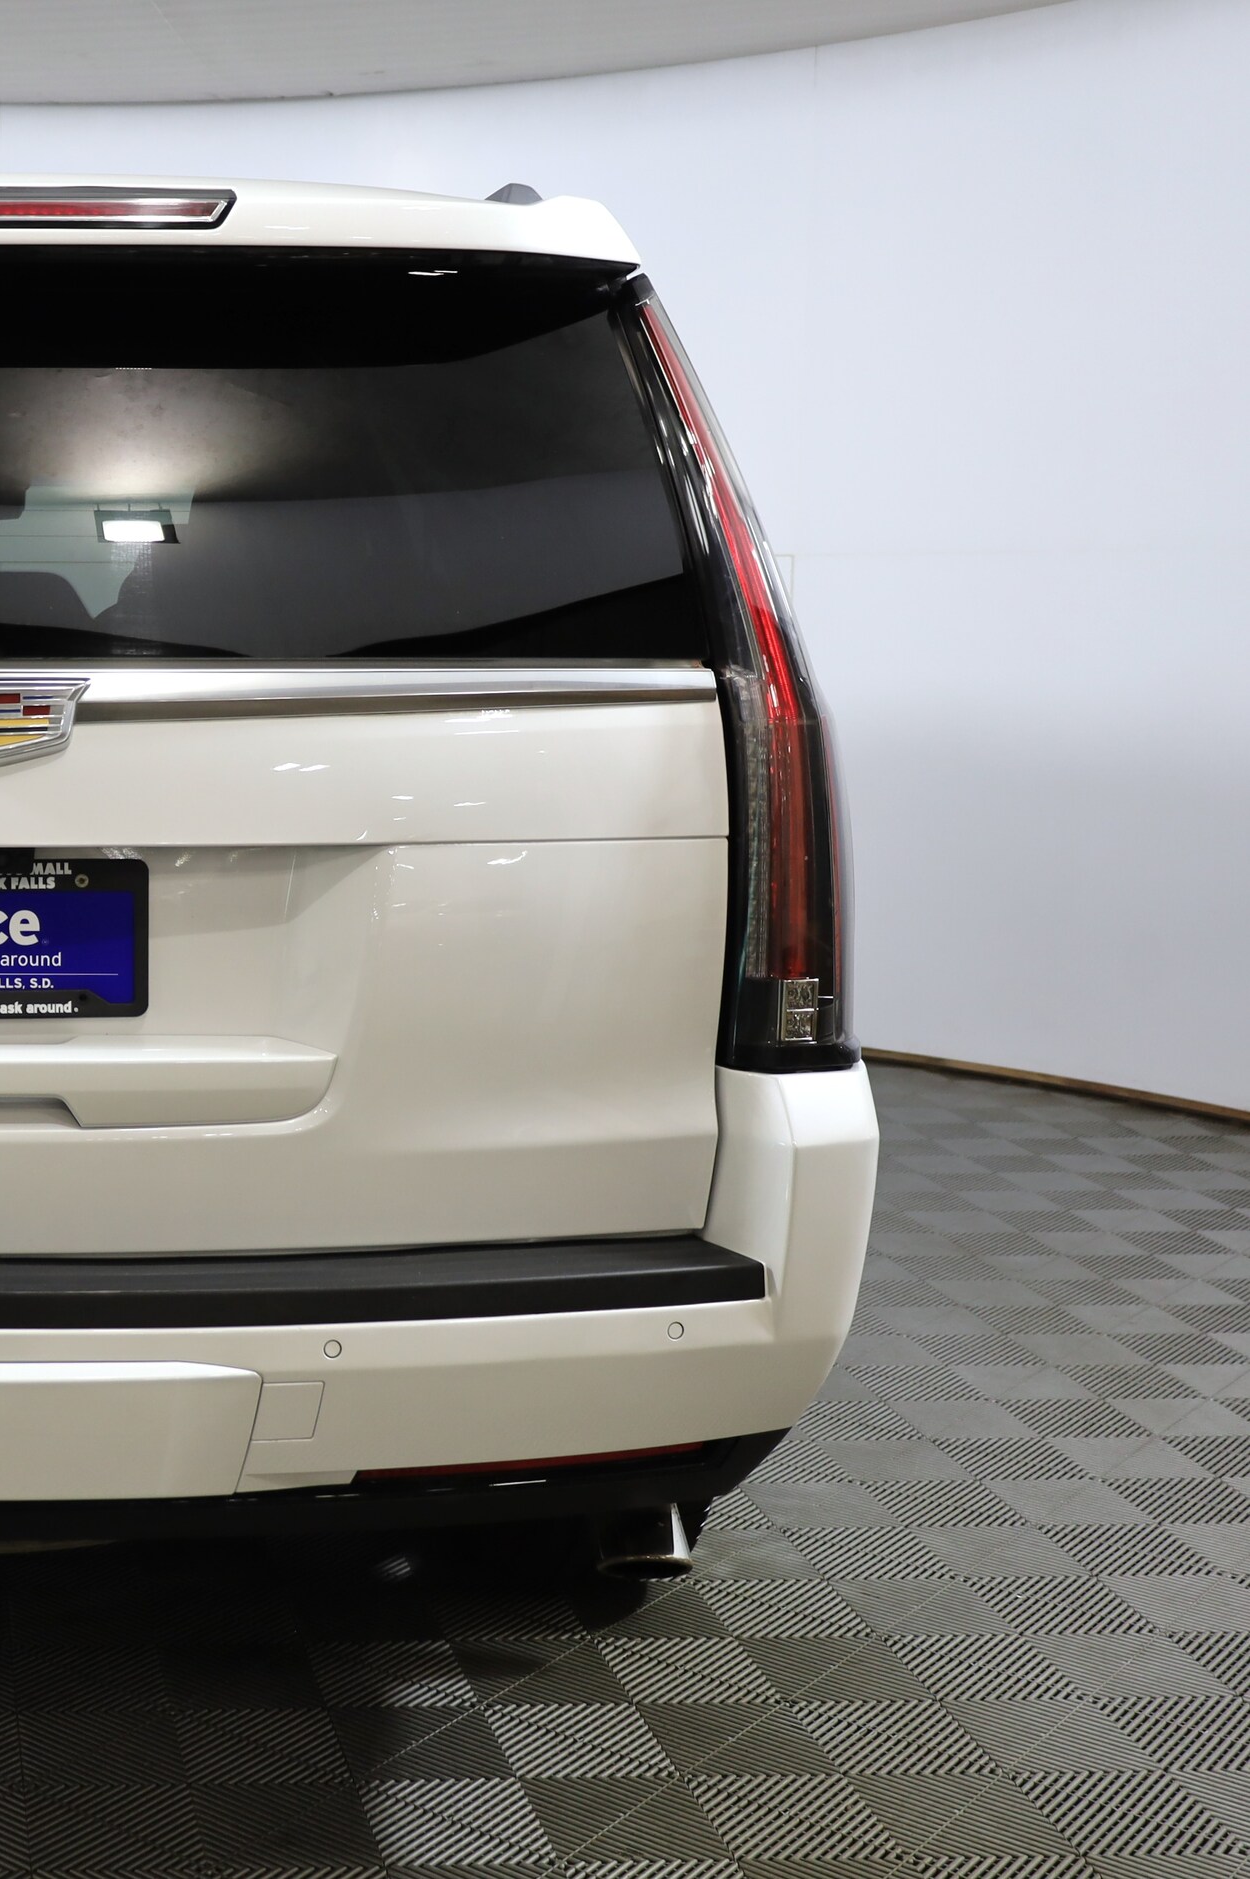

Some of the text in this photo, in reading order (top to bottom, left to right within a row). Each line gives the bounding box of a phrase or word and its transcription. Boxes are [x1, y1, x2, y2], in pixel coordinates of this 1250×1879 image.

[30, 862, 72, 875] MALL
[11, 876, 56, 889] FALLS
[0, 951, 62, 967] around
[29, 977, 54, 989] S.D.
[0, 1001, 23, 1014] ask
